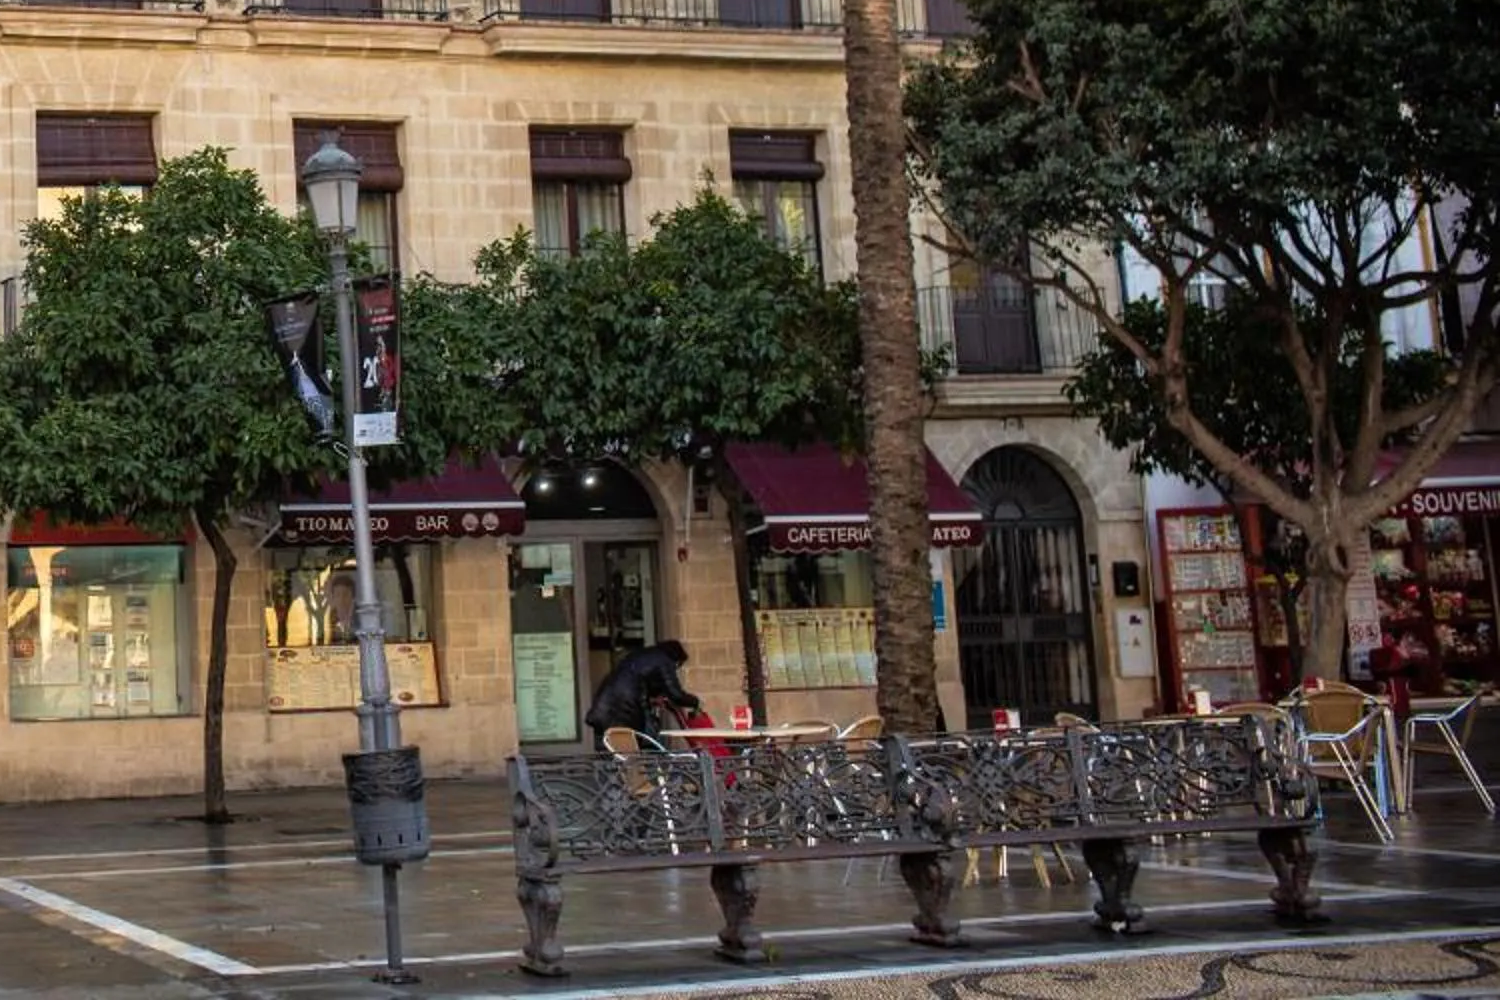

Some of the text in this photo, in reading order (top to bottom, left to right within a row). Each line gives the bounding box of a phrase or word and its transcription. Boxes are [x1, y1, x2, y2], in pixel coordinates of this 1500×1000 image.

[1411, 490, 1500, 514] SOUVENI
[295, 515, 449, 532] TIO MAEO BAR
[787, 526, 972, 544] CAFETERIA ATEO
